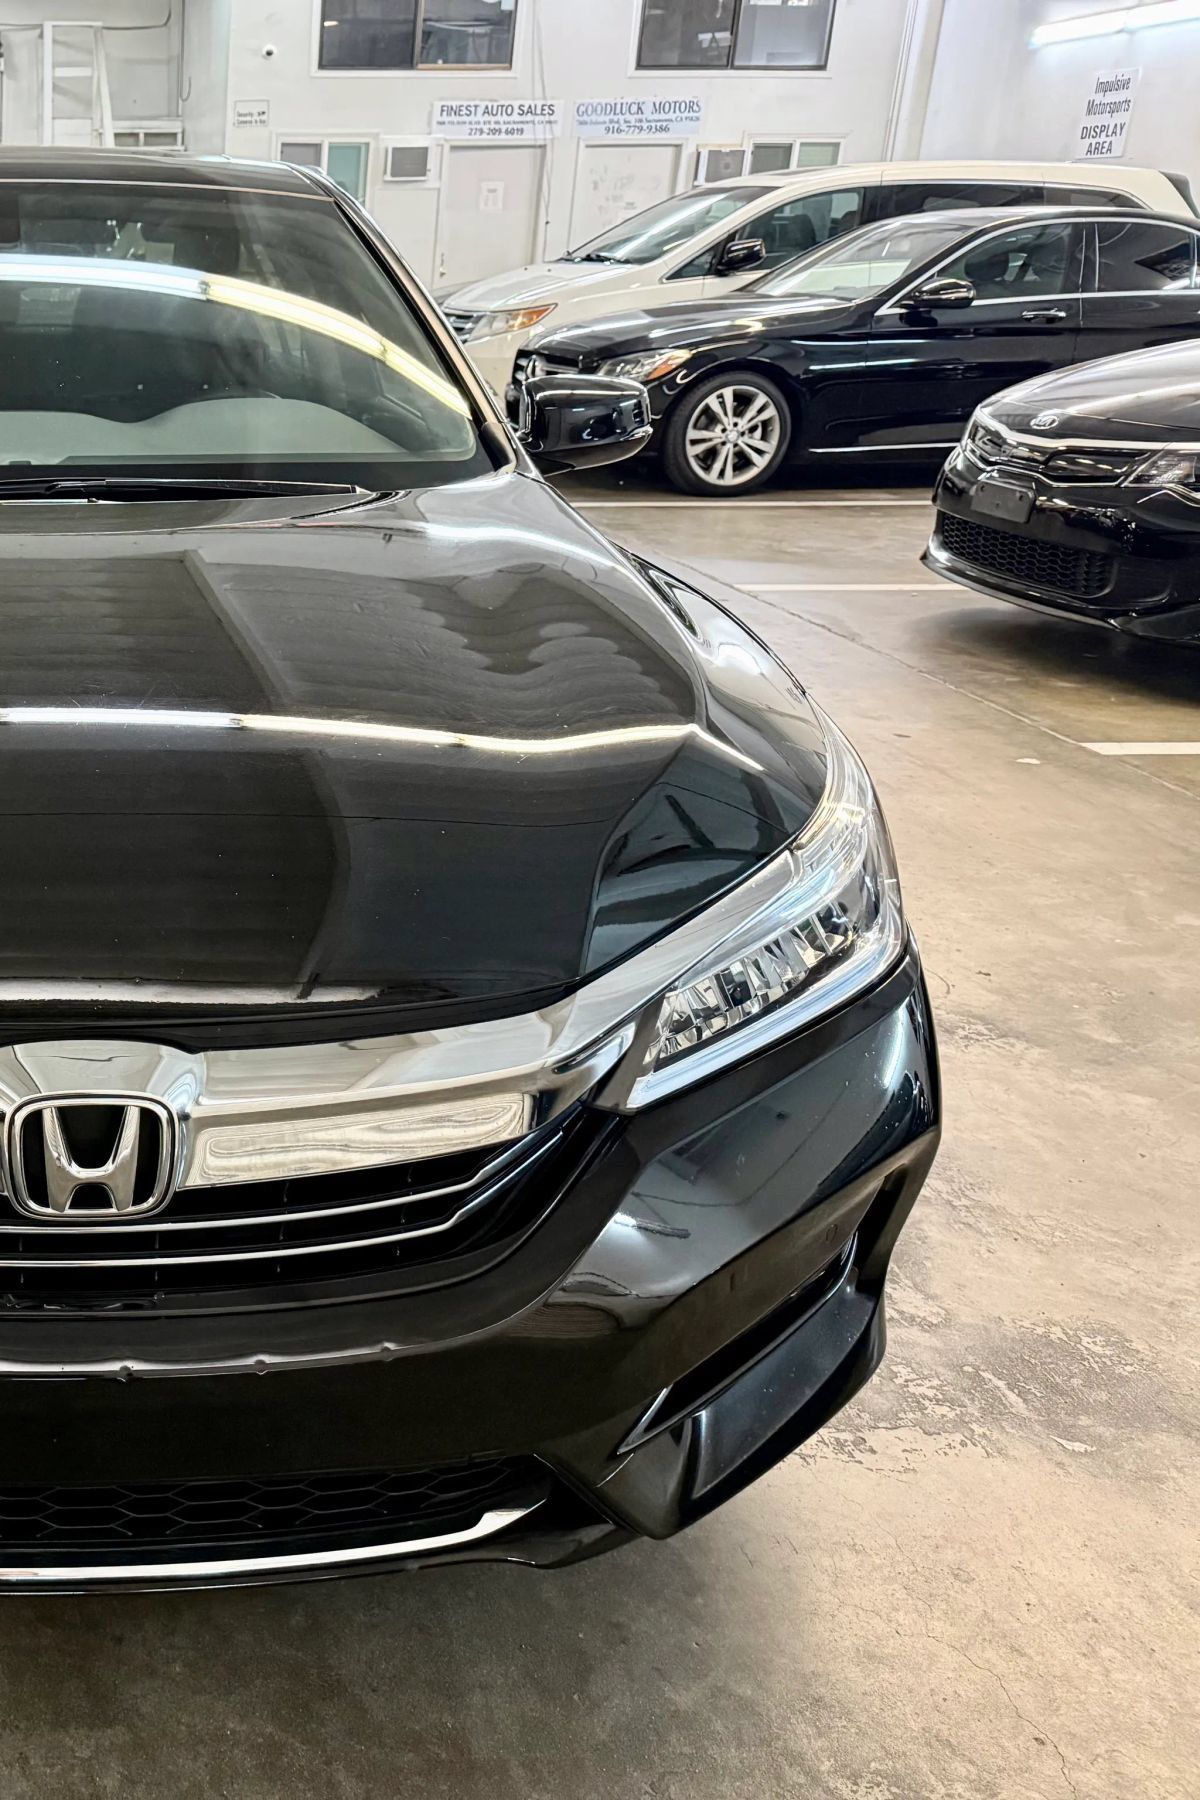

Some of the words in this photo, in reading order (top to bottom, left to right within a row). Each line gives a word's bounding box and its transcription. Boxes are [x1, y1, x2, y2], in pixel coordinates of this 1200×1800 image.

[1095, 73, 1131, 97] Impulsive
[440, 104, 479, 117] FINEST
[482, 104, 514, 117] AUTO
[517, 104, 555, 116] SALES
[576, 101, 645, 117] GOODLUCK
[651, 100, 701, 115] MOTORS
[1086, 98, 1131, 118] Motorsports
[468, 127, 525, 136] 279-209-6019
[605, 125, 670, 135] 916-779-9386
[1080, 122, 1126, 140] DISPLAY
[1085, 141, 1113, 156] AREA
